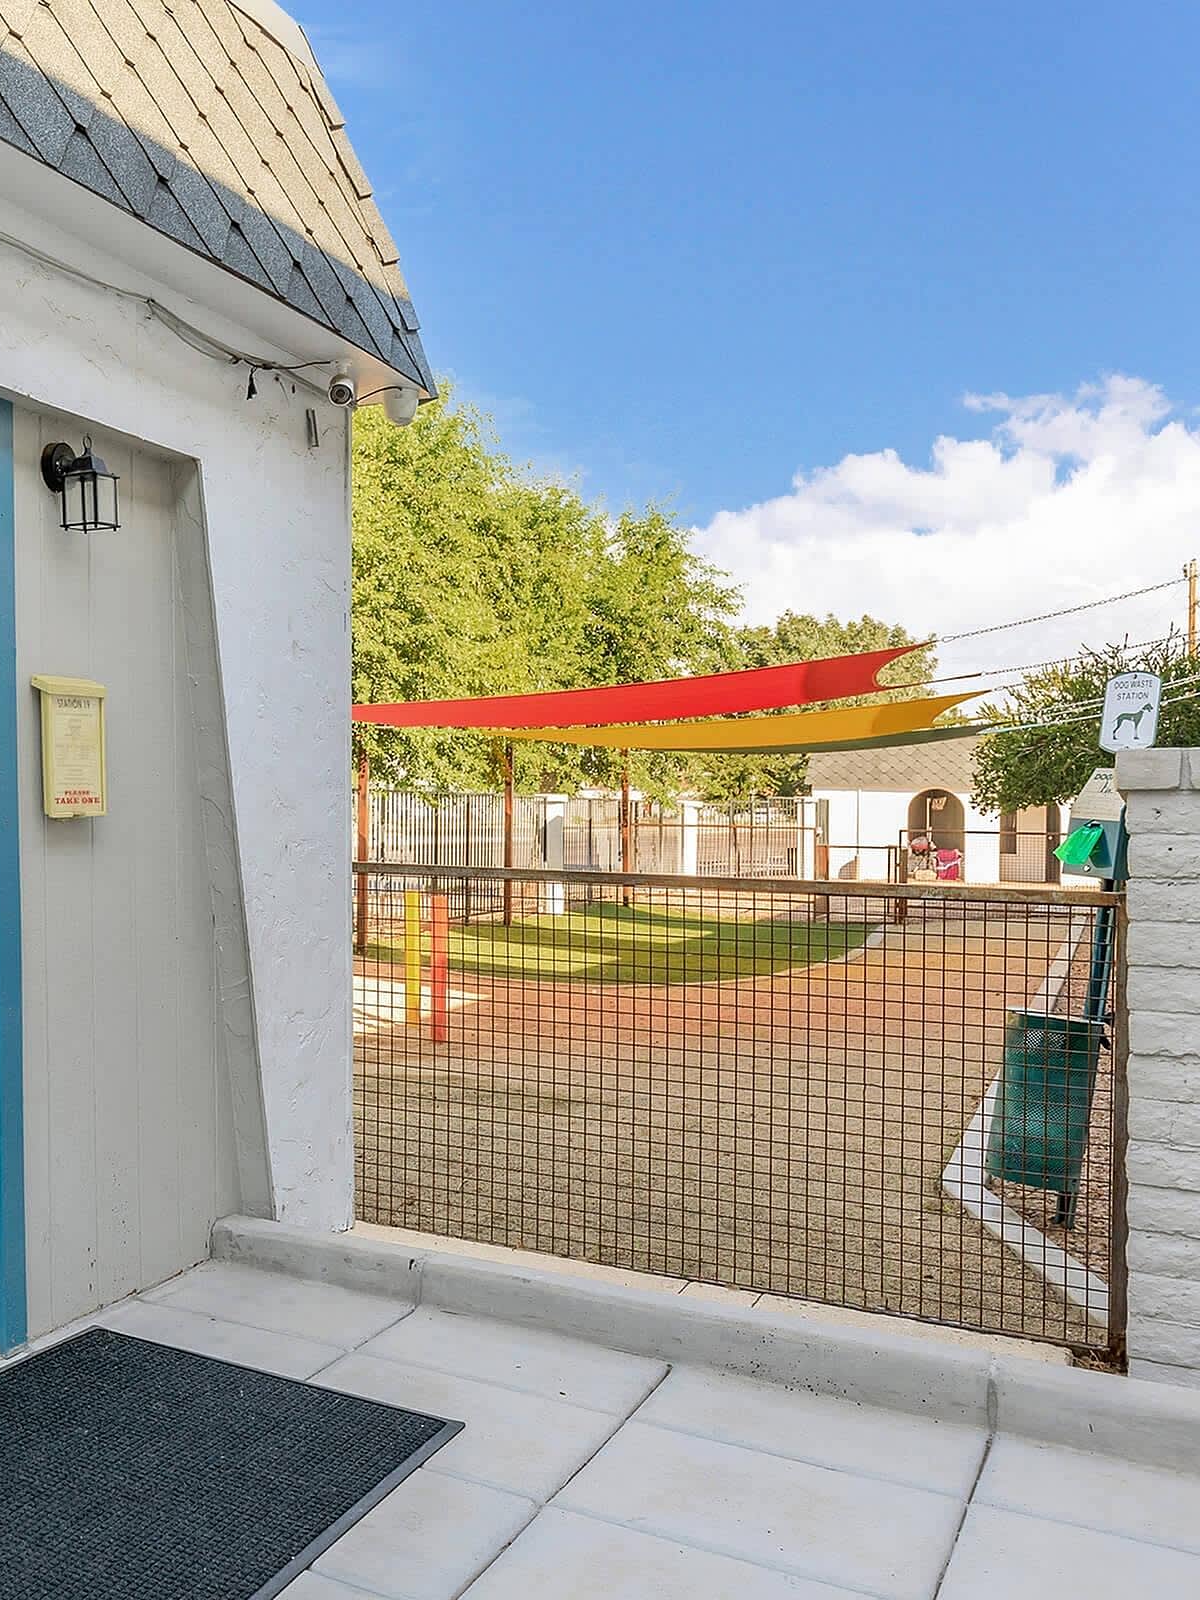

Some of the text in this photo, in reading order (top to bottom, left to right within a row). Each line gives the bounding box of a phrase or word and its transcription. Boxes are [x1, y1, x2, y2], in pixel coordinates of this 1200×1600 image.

[1114, 679, 1153, 690] DOG WASTE
[1116, 691, 1149, 700] STATION
[54, 796, 101, 805] TAKE ONE
